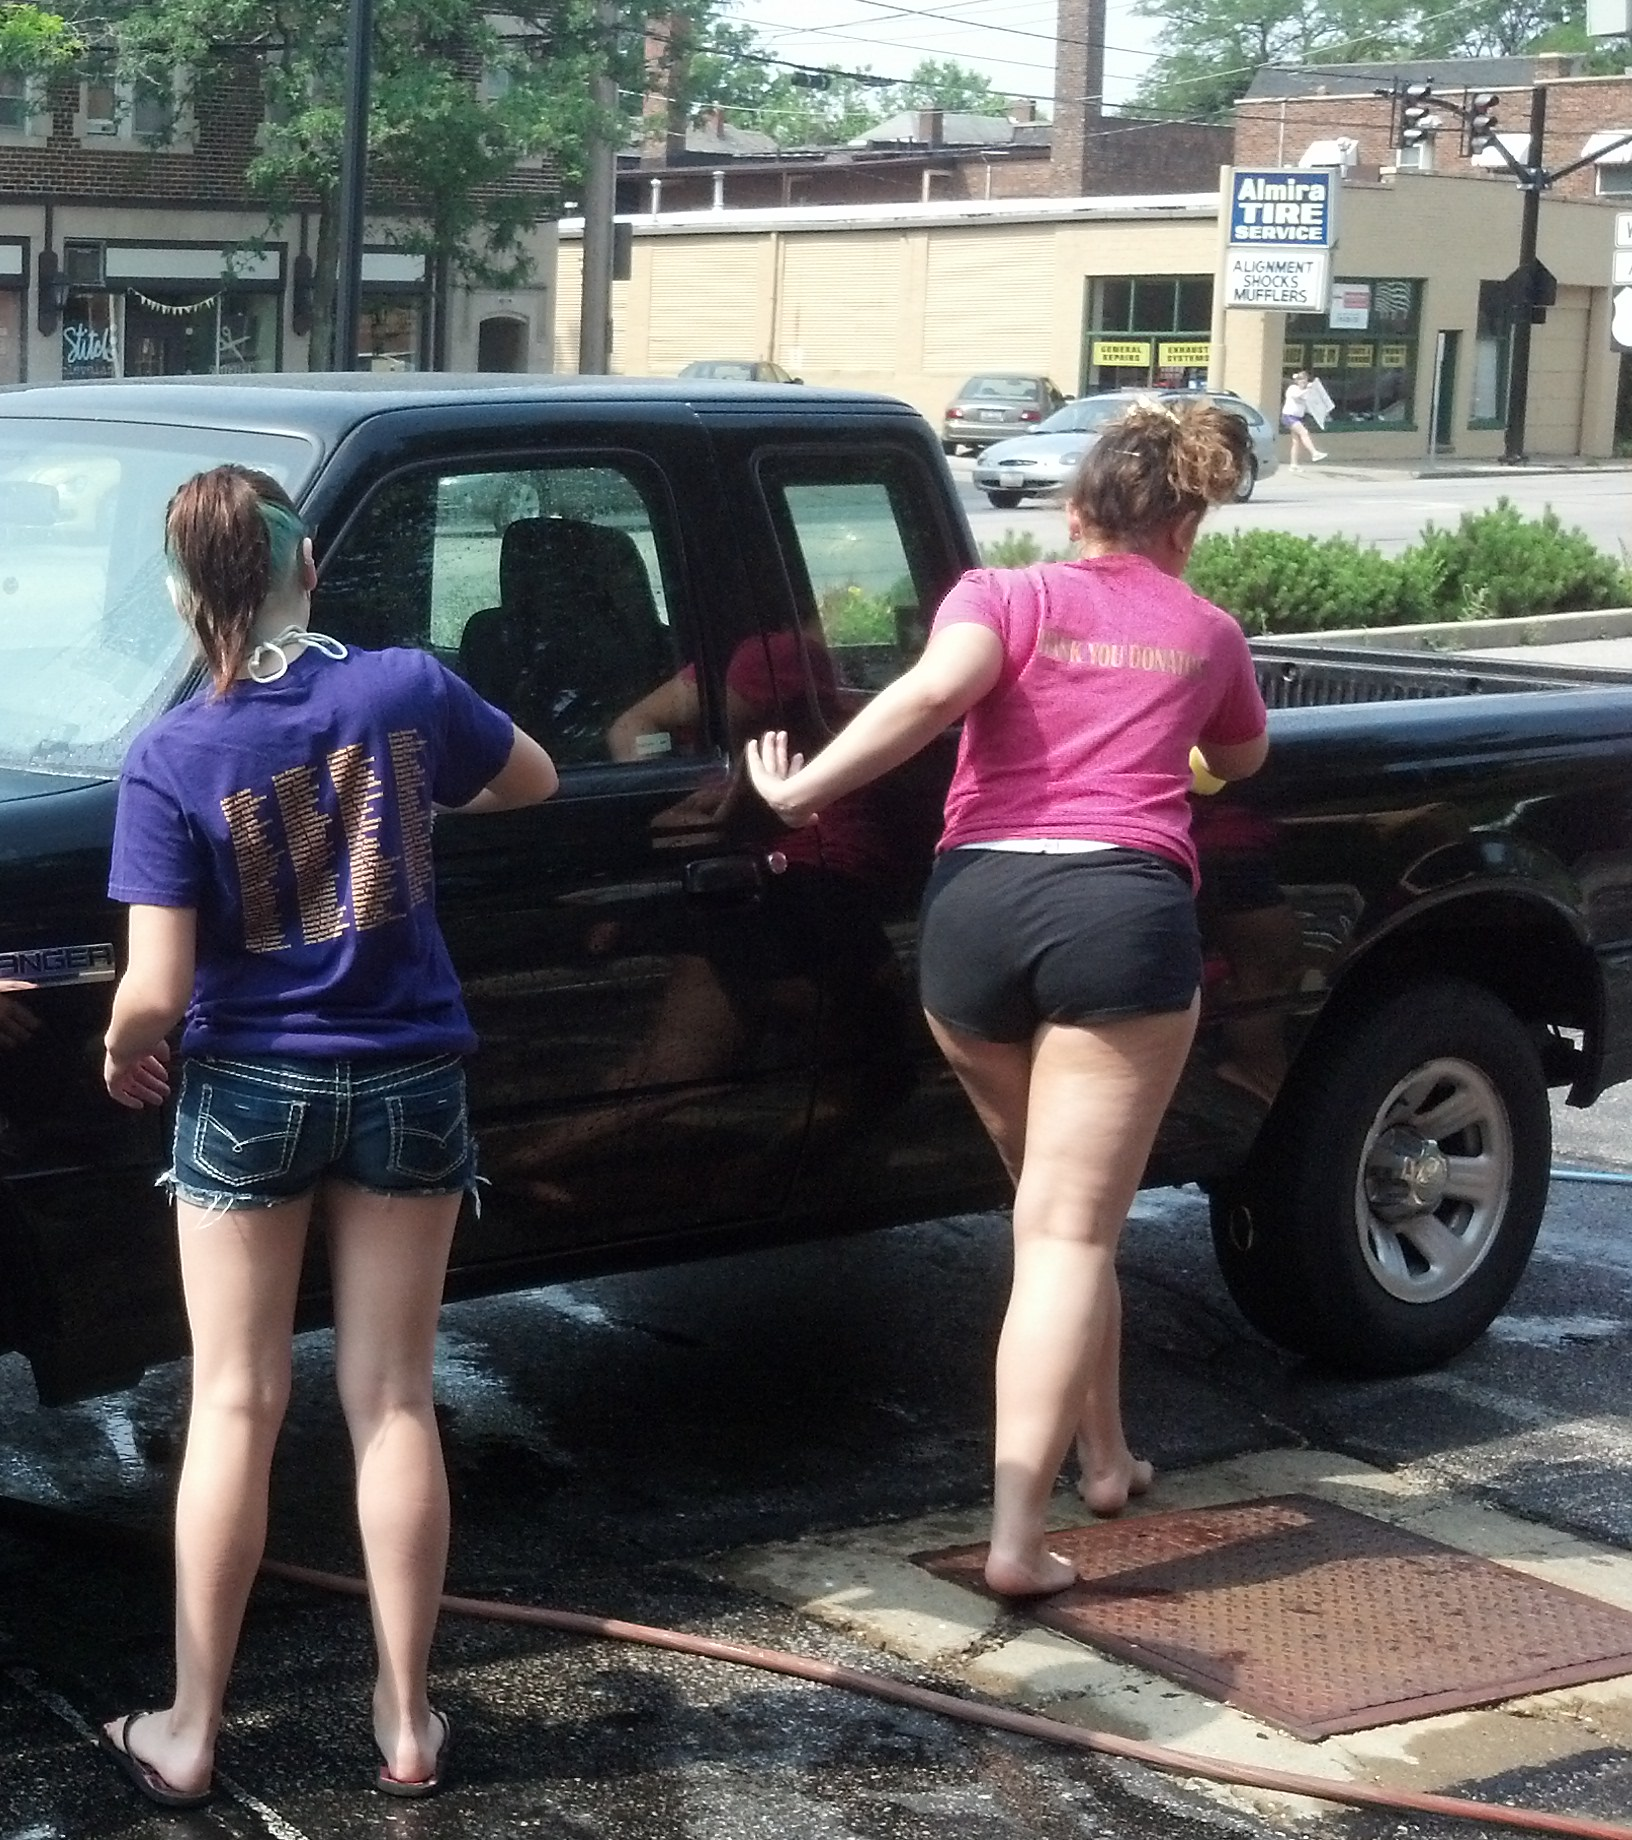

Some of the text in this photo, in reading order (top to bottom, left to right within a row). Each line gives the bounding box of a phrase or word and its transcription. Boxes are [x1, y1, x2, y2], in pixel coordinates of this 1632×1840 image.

[1237, 178, 1326, 201] Almira
[1238, 202, 1324, 225] TIRE
[1234, 225, 1323, 240] SERVICE
[1233, 260, 1314, 273] ALIGNMENT
[1243, 275, 1299, 288] SHOCKS
[1233, 289, 1308, 303] MUFFLERS
[1101, 346, 1142, 354] GENERAL
[1167, 346, 1208, 354] EXHAUST
[1102, 354, 1140, 362] REPAIRS
[1088, 642, 1125, 668] YOU
